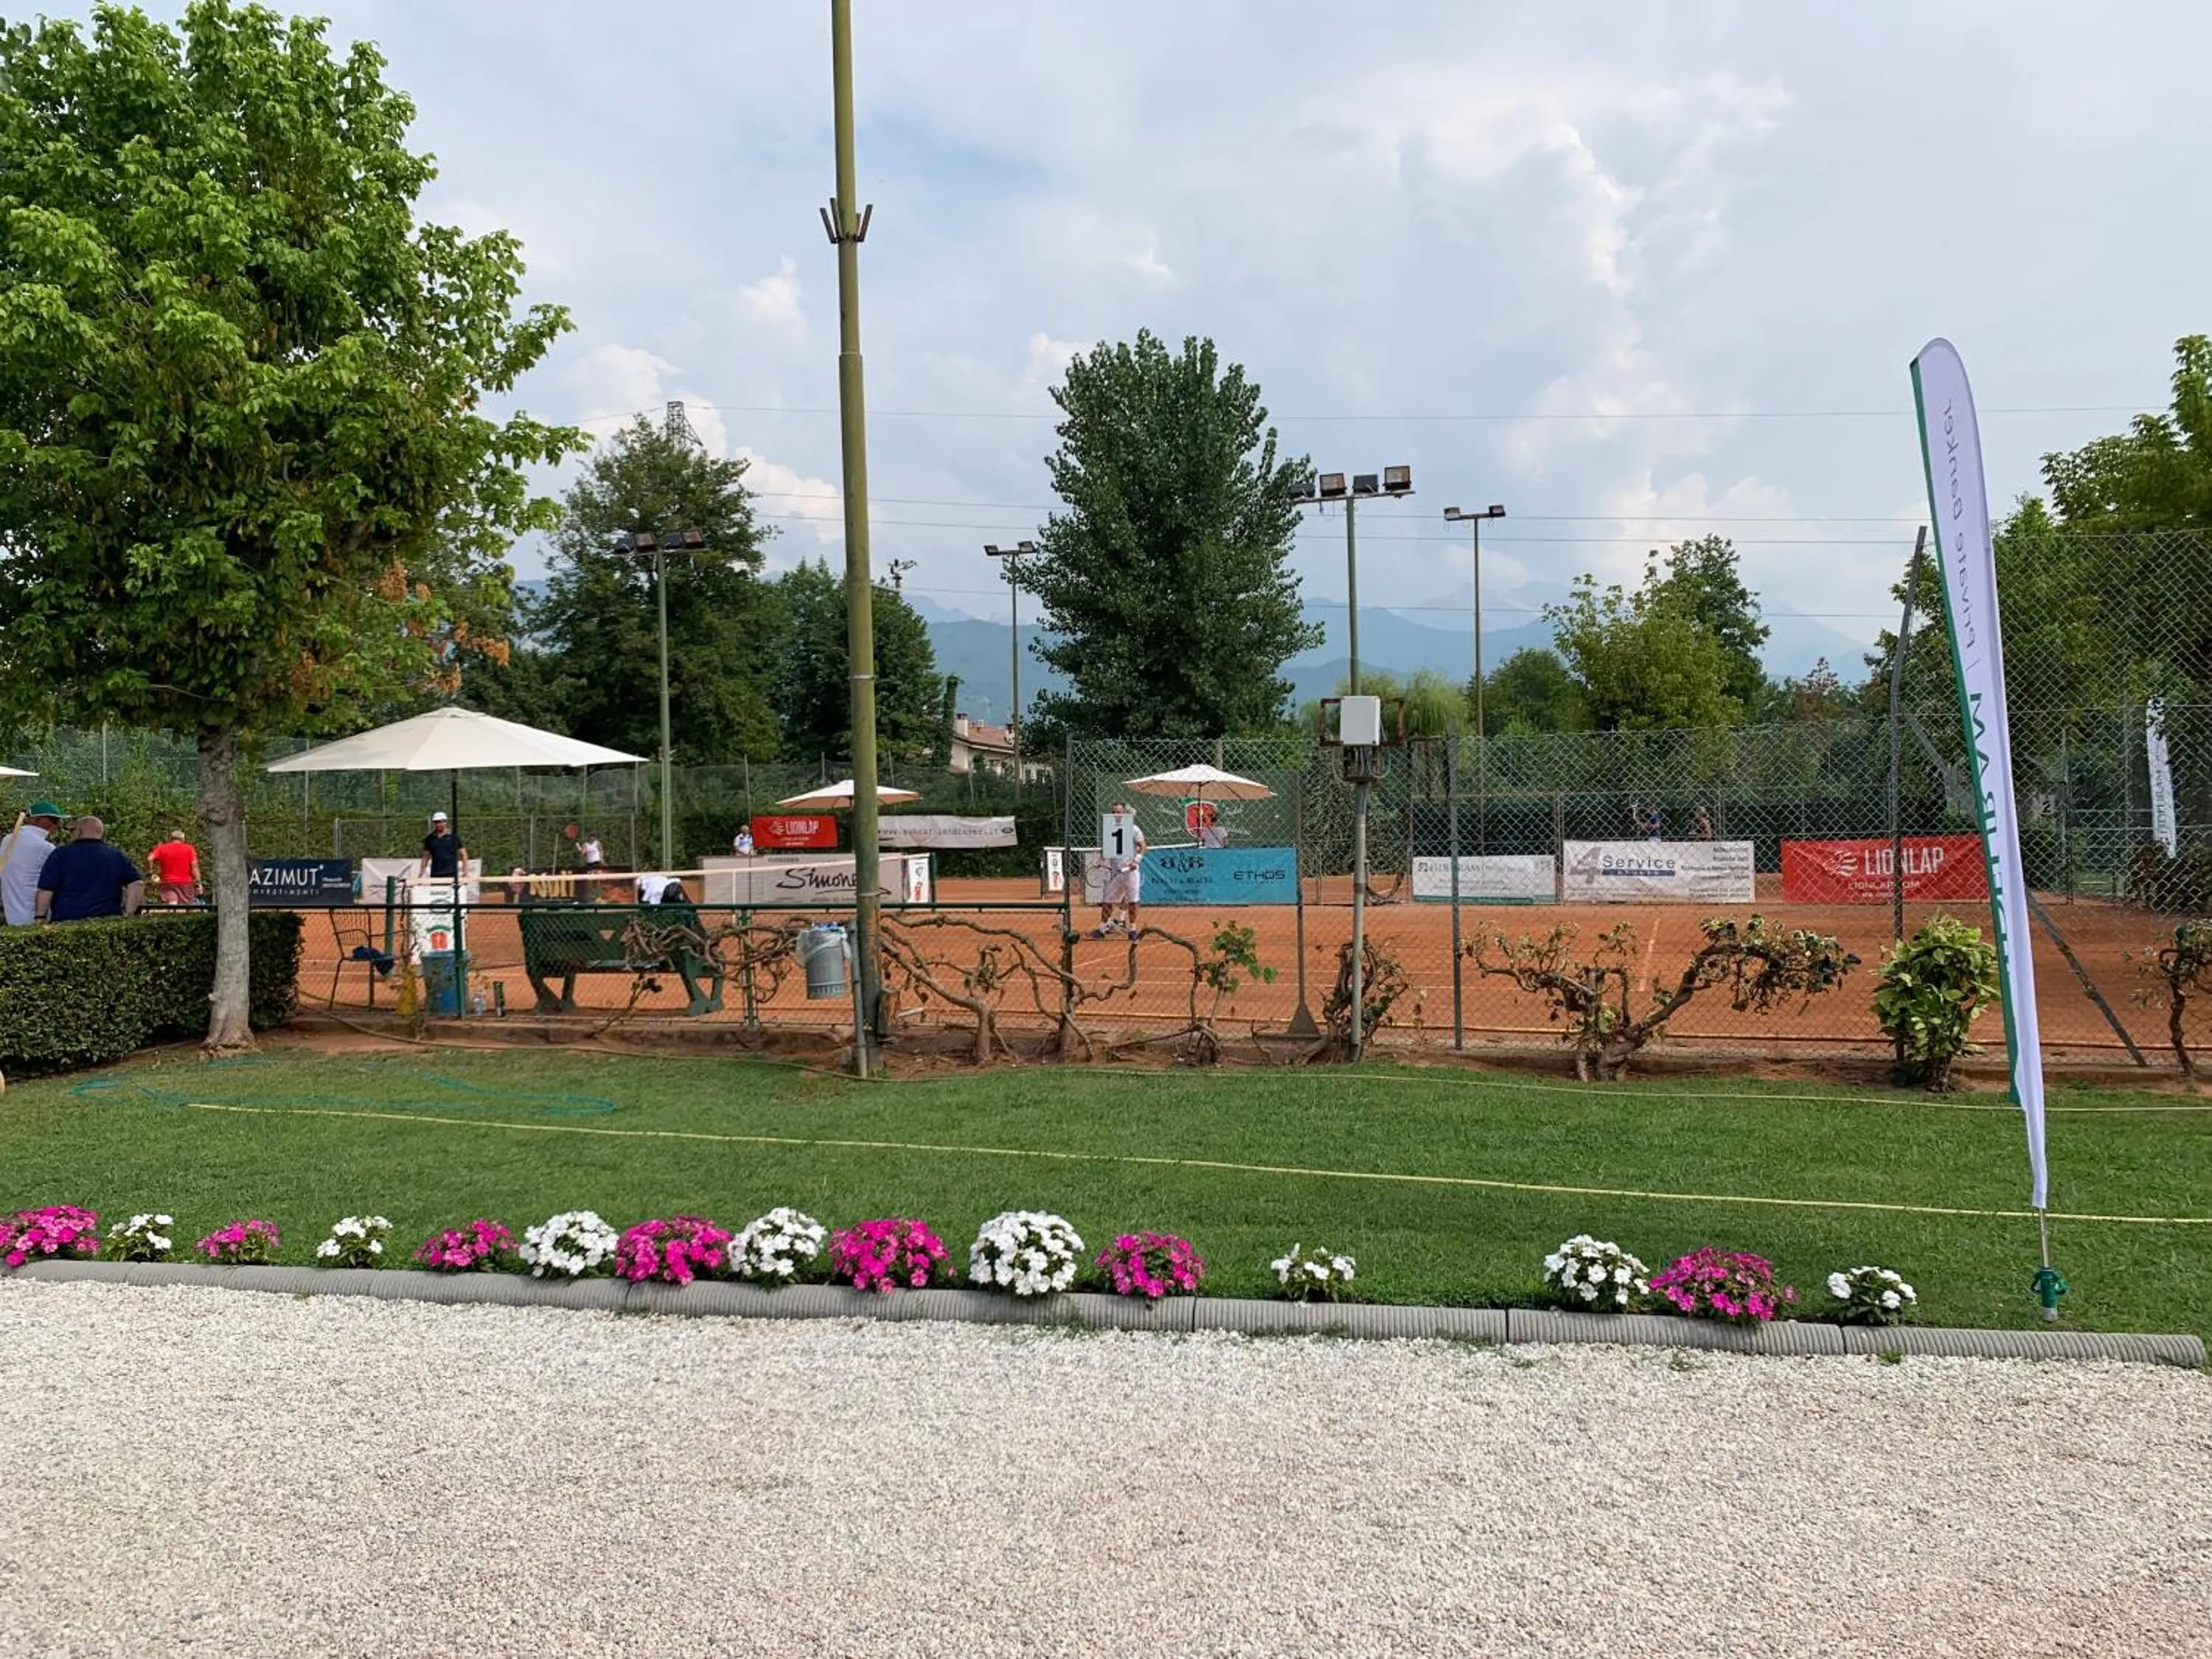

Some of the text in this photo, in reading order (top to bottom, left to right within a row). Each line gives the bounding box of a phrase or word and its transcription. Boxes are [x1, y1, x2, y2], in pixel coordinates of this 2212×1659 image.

[2042, 800, 2051, 813] 2
[1111, 828, 1123, 855] 1
[1569, 846, 1602, 885] 4
[1602, 855, 1676, 869] Service
[1865, 846, 1944, 875] LIONLAP
[248, 868, 320, 886] AZIMUT
[1233, 869, 1286, 880] ETHOS
